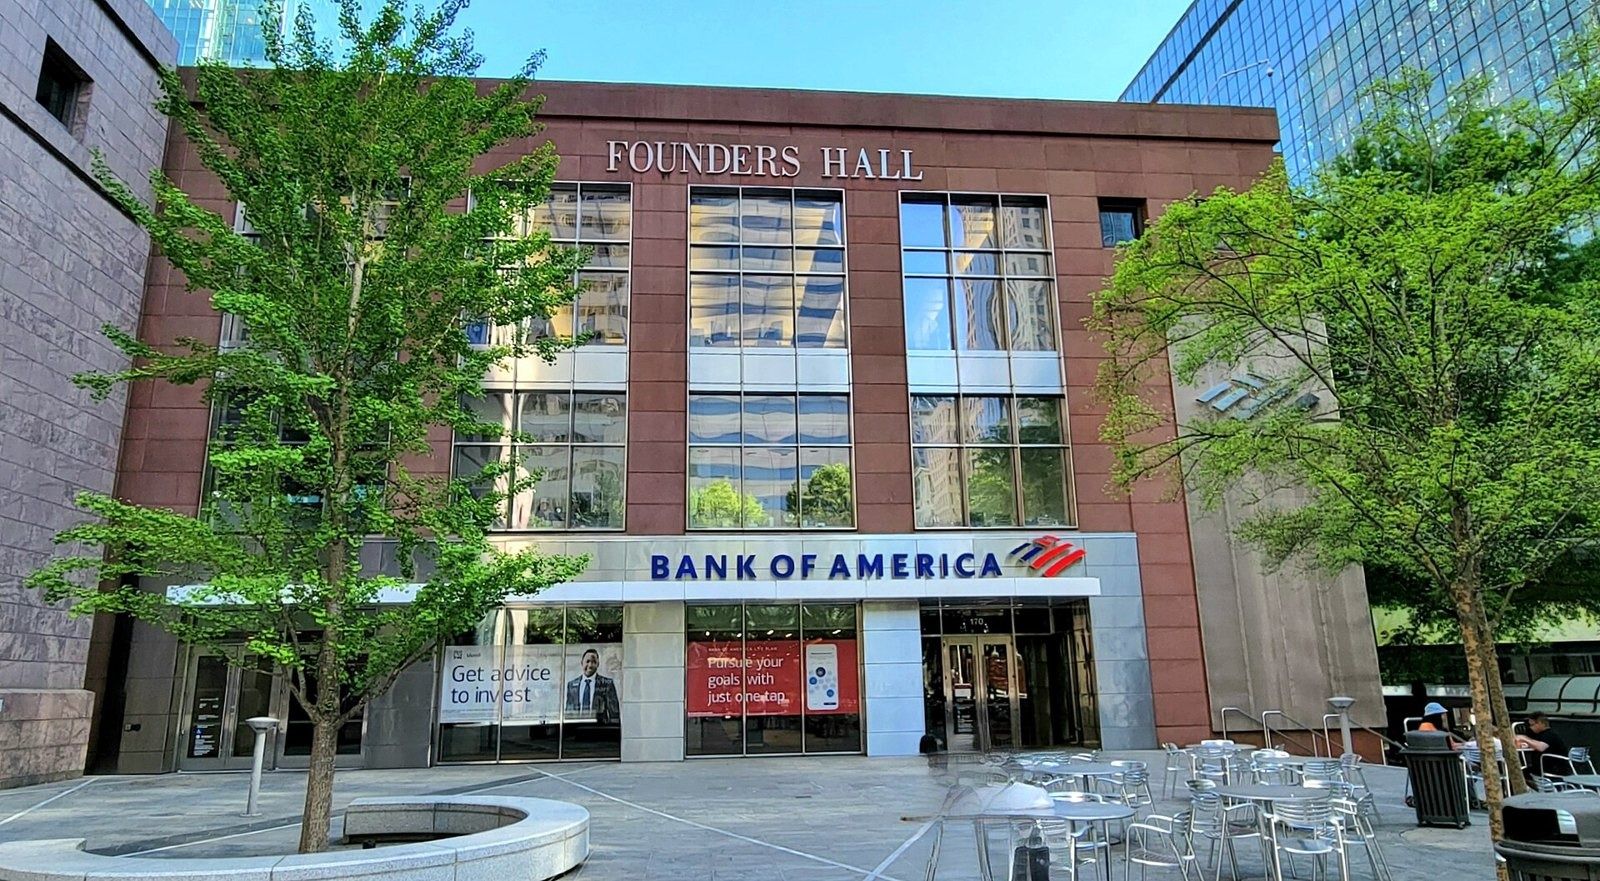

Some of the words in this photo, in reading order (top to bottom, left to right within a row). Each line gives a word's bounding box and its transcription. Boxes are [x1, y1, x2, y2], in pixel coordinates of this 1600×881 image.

[606, 140, 801, 178] FOUNDERS
[820, 147, 924, 181] HALL
[651, 553, 756, 580] BANK
[769, 553, 818, 579] OF
[829, 552, 1003, 580] AMERICA
[970, 617, 984, 625] 170
[707, 656, 753, 669] Pursue
[756, 656, 784, 671] your
[452, 665, 485, 683] Get
[490, 664, 551, 683] advice
[707, 672, 741, 689] goals
[747, 672, 774, 686] with
[451, 687, 469, 704] to
[475, 686, 532, 704] invest
[706, 690, 731, 706] just
[735, 693, 761, 703] one
